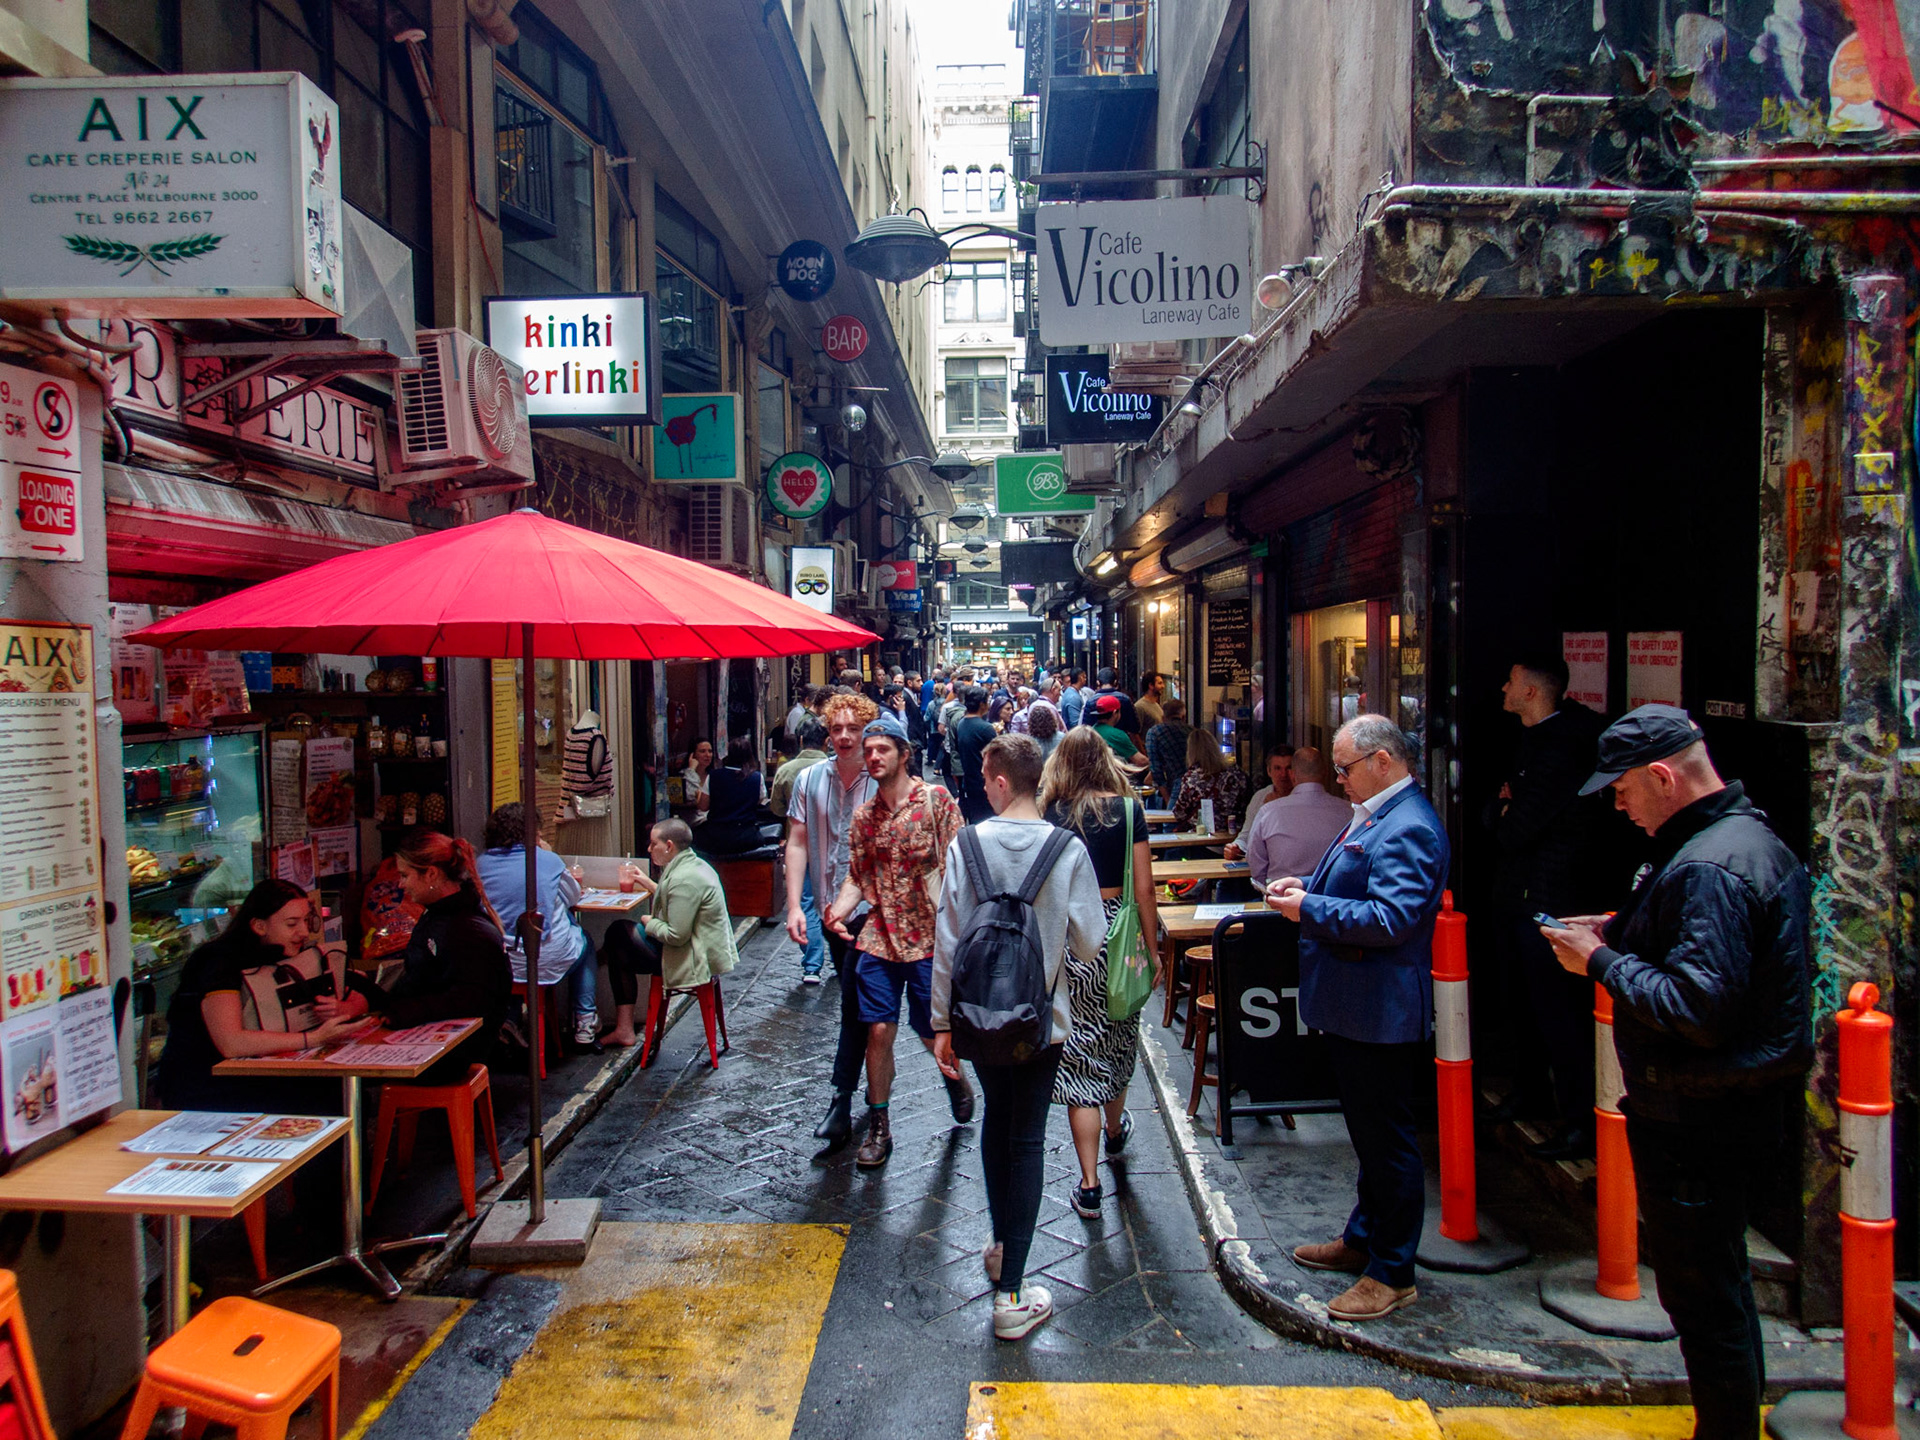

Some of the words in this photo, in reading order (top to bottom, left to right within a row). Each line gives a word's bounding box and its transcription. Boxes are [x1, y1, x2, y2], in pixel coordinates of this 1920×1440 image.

[78, 96, 207, 142] AIX
[28, 154, 79, 167] CAFE
[87, 152, 183, 166] CREPERIE
[191, 151, 257, 164] SALON
[222, 191, 259, 201] 3000
[113, 212, 160, 224] 9662
[168, 211, 213, 223] 2667
[1100, 231, 1142, 255] Cafe
[786, 257, 825, 269] MOON
[1044, 226, 1240, 307] Vicolino
[788, 269, 818, 281] DOG
[1142, 307, 1202, 325] Laneway
[1208, 303, 1240, 320] Cafe
[524, 313, 612, 348] kinki
[827, 325, 861, 351] BAR
[525, 359, 640, 396] erlinki
[1086, 377, 1106, 387] Cafe
[1058, 371, 1151, 414] Vicolino
[1105, 411, 1134, 421] Laneway
[1135, 411, 1151, 420] Cafe
[783, 477, 815, 487] HELL'S
[20, 479, 74, 505] LOADING
[1575, 639, 1591, 648] SAFETY
[1592, 639, 1605, 648] DOOR
[1630, 640, 1640, 650] FIRE
[1641, 640, 1661, 650] SAFETY
[1662, 640, 1678, 651] DOOR
[4, 635, 68, 667] AIX
[1565, 653, 1571, 662] DO
[1571, 653, 1581, 662] NOT
[1582, 653, 1605, 663] OBSTRUCT
[1630, 655, 1636, 664] DO
[1637, 655, 1648, 665] NOT
[1649, 655, 1678, 666] OBSTRUCT
[0, 699, 53, 708] REAKFAST
[54, 698, 81, 707] MENU
[1707, 702, 1720, 713] POST
[1721, 703, 1730, 714] NO
[20, 905, 54, 921] DRINKS
[55, 900, 81, 910] MENU
[1240, 986, 1324, 1038] ST
